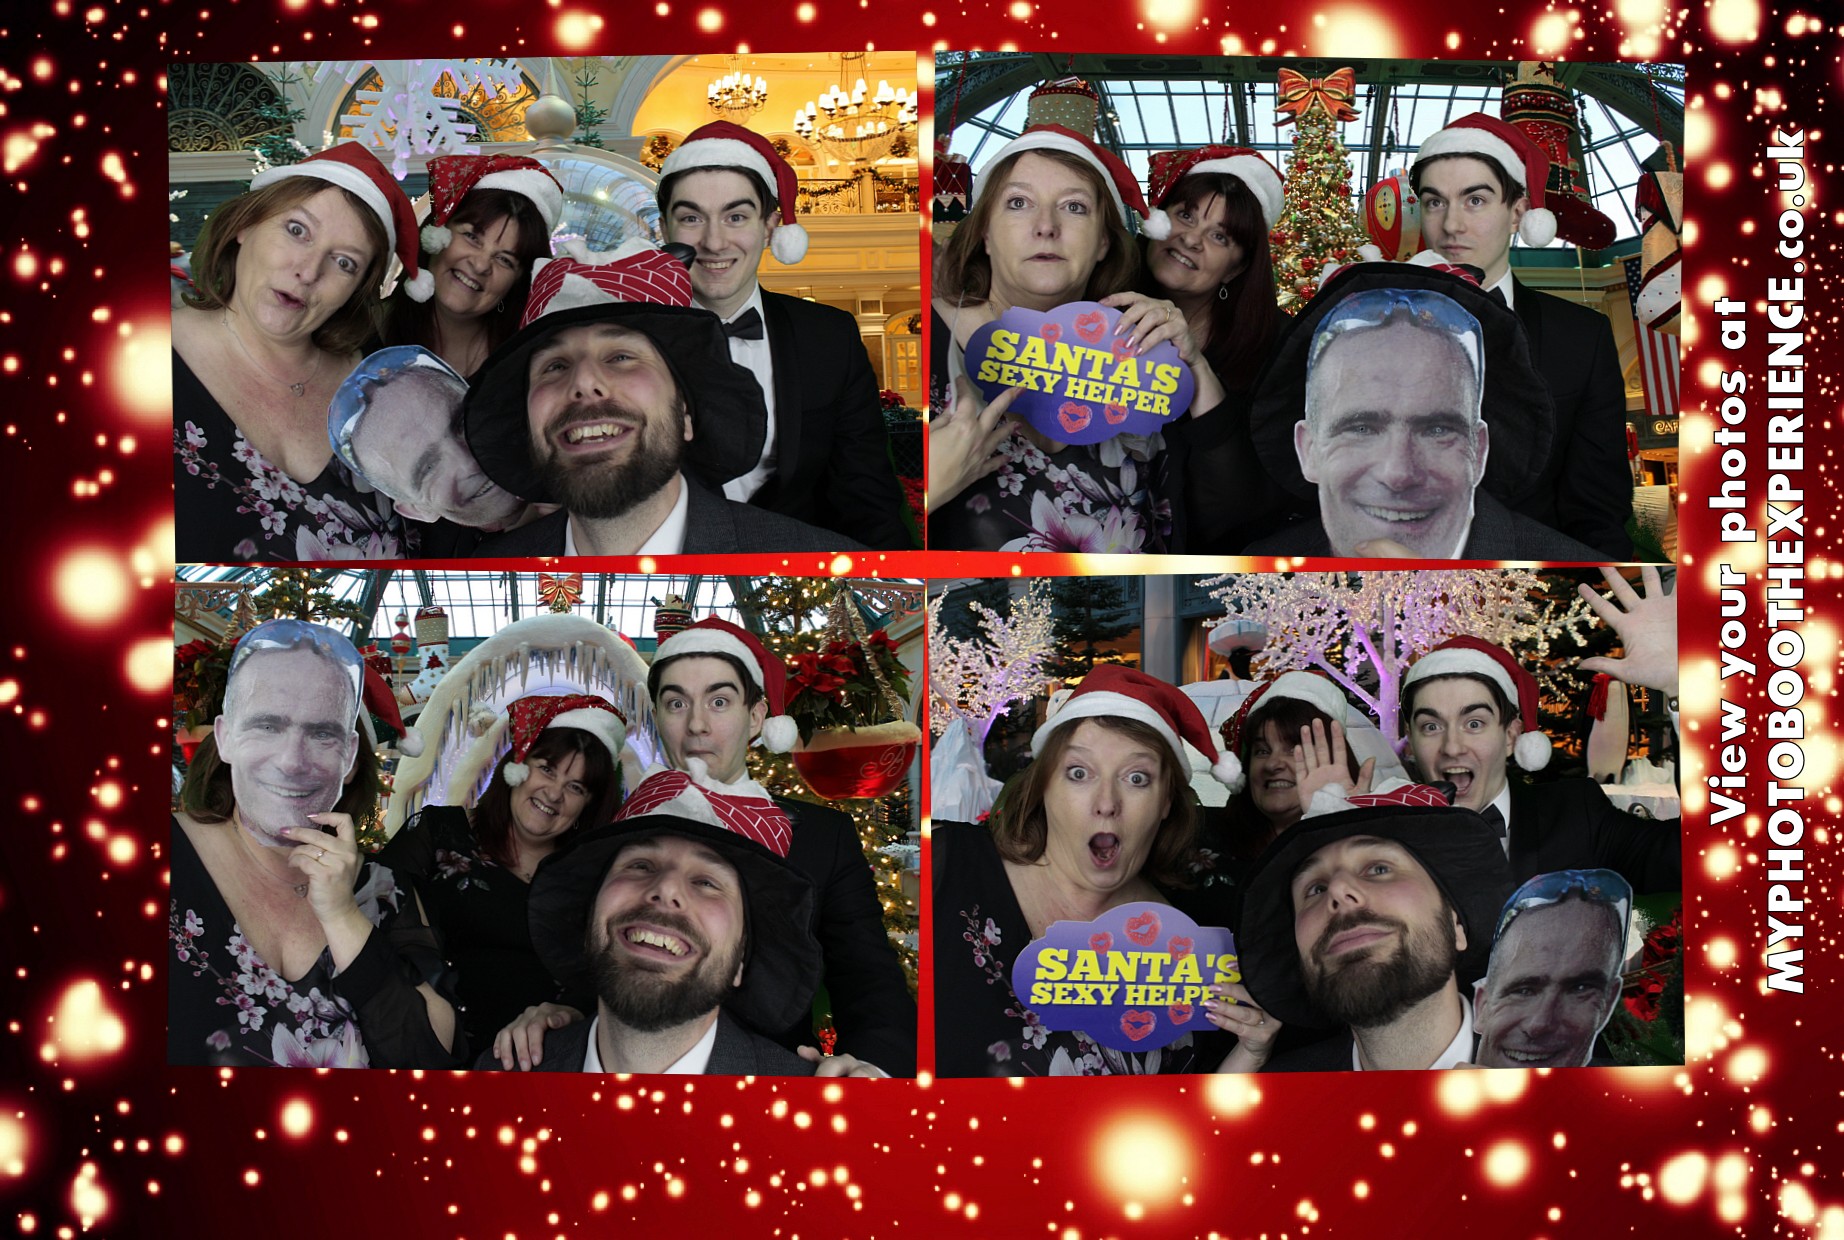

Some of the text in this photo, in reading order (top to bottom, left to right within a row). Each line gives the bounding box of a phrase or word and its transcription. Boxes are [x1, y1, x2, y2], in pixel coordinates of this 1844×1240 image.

[985, 328, 1182, 396] SANTA'S
[977, 360, 1171, 416] SEXY HELPER
[1035, 948, 1242, 984] SANTA'S
[1030, 982, 1120, 1005] SEXY
